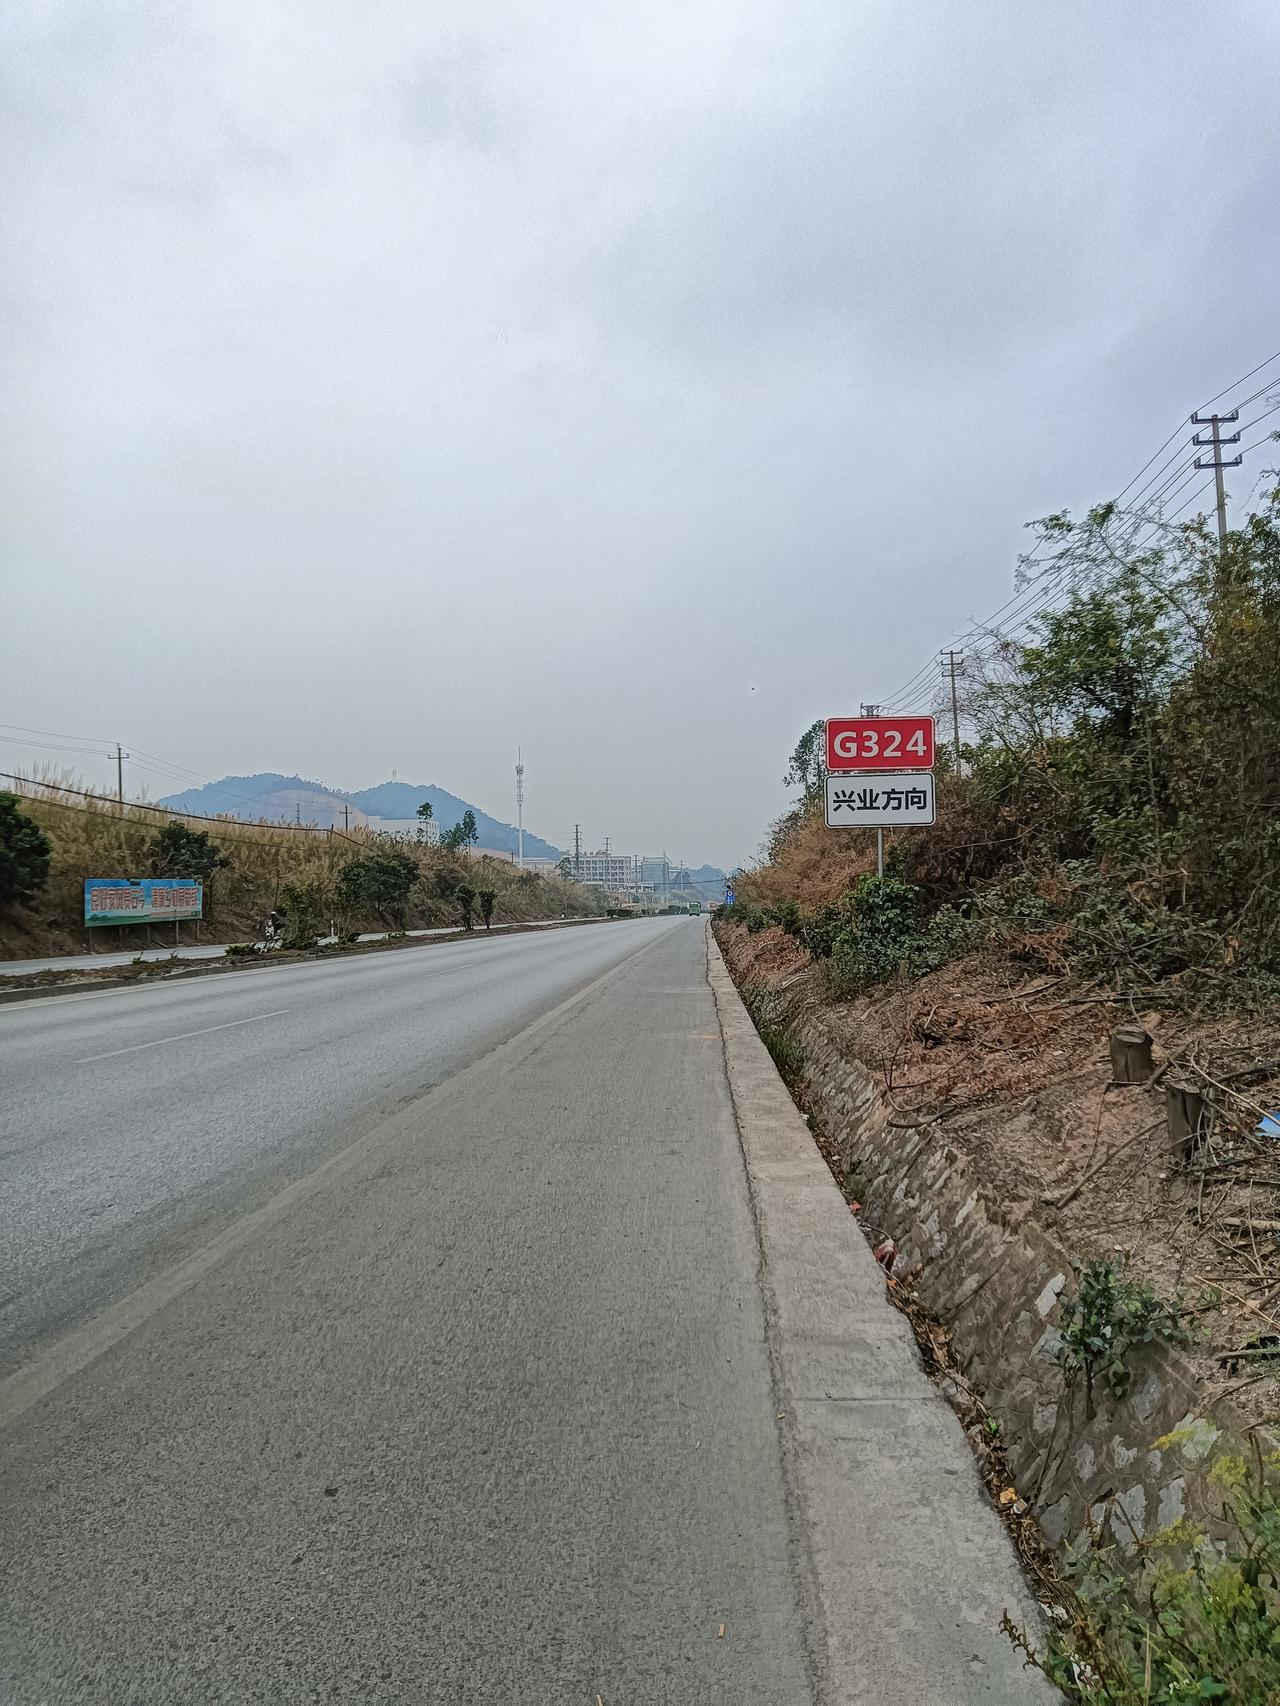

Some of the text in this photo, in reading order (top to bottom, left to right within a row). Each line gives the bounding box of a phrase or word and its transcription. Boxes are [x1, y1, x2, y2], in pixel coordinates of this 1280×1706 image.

[833, 730, 927, 758] G324
[833, 787, 927, 812] 兴业方向
